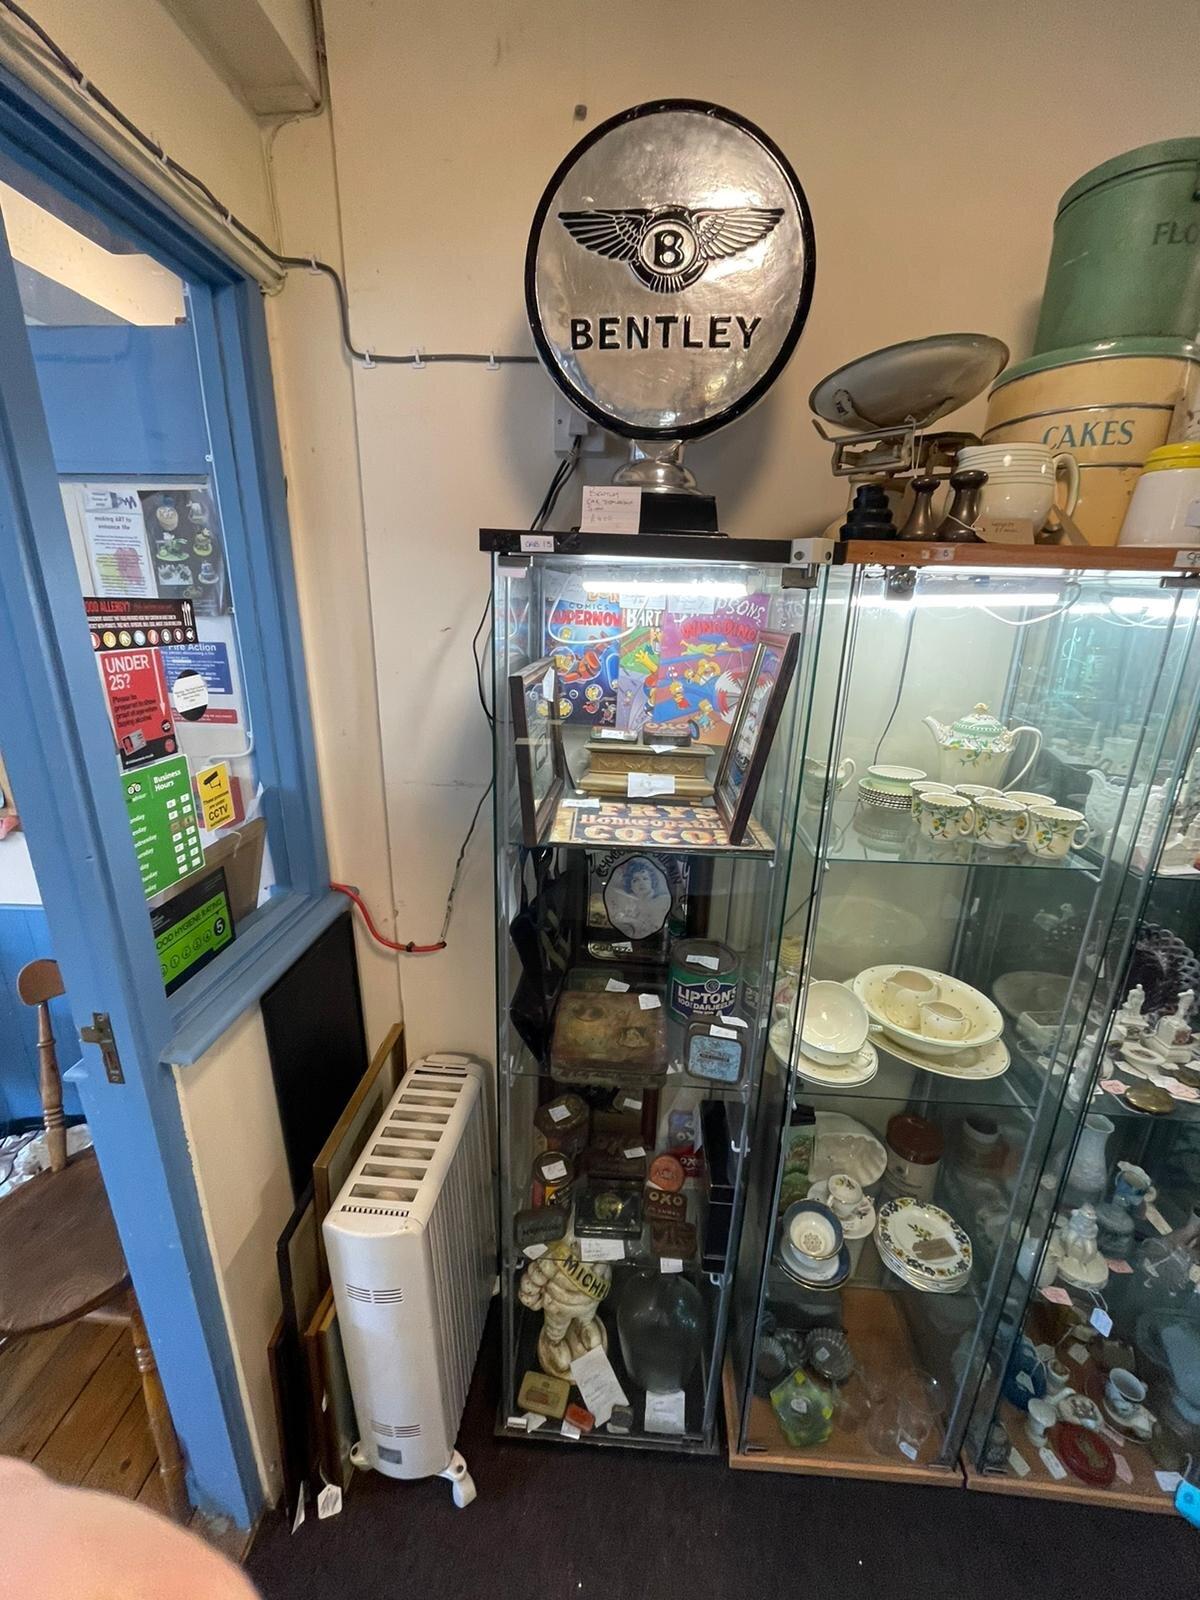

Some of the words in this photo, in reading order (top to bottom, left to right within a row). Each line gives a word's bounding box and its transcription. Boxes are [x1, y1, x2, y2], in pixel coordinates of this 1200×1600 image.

[653, 229, 683, 268] B
[570, 315, 762, 351] BENTLEY
[1042, 420, 1136, 450] CAKES
[568, 602, 609, 610] COMICS
[626, 608, 662, 628] BART
[187, 643, 217, 651] Action
[105, 654, 151, 674] UNDER
[109, 673, 131, 691] 25?
[153, 769, 181, 784] Business
[155, 780, 174, 792] Hours
[208, 803, 228, 821] CCTV
[174, 913, 201, 937] HYGIENE
[201, 897, 223, 917] RATING
[216, 919, 224, 934] 5
[649, 1191, 683, 1206] OXO
